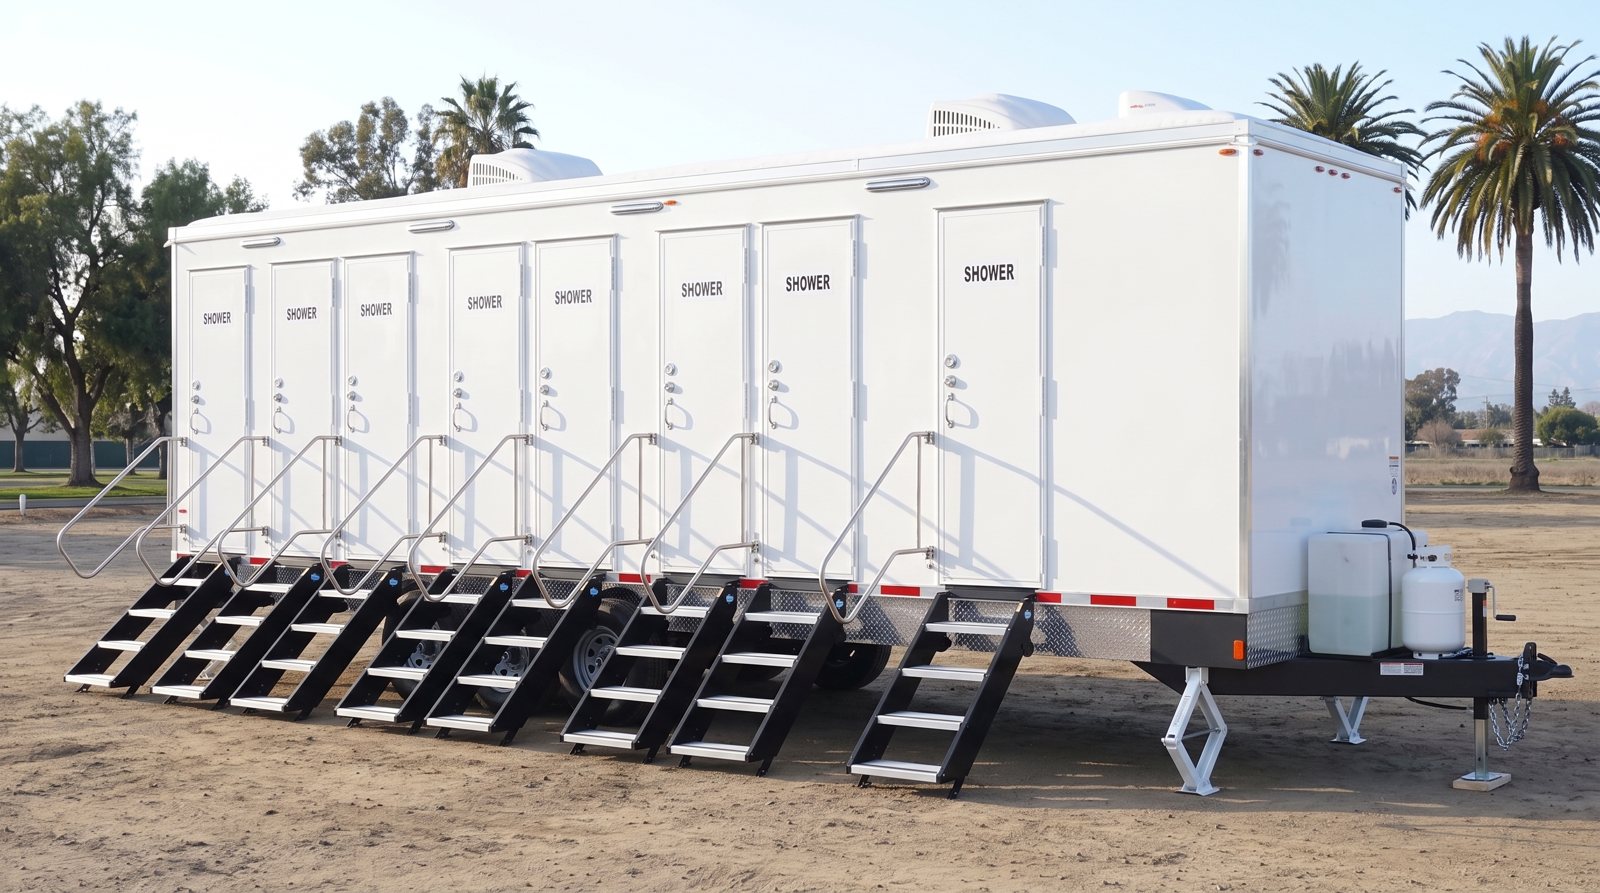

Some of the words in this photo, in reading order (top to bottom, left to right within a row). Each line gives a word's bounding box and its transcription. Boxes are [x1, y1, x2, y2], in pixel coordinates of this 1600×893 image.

[964, 264, 1014, 282] SHOWER
[682, 281, 722, 297] SHOWER
[786, 275, 830, 292] SHOWER
[468, 295, 502, 310] SHOWER
[555, 288, 592, 304] SHOWER
[287, 307, 317, 321] SHOWER
[361, 303, 392, 317] SHOWER
[204, 312, 231, 325] SHOWER
